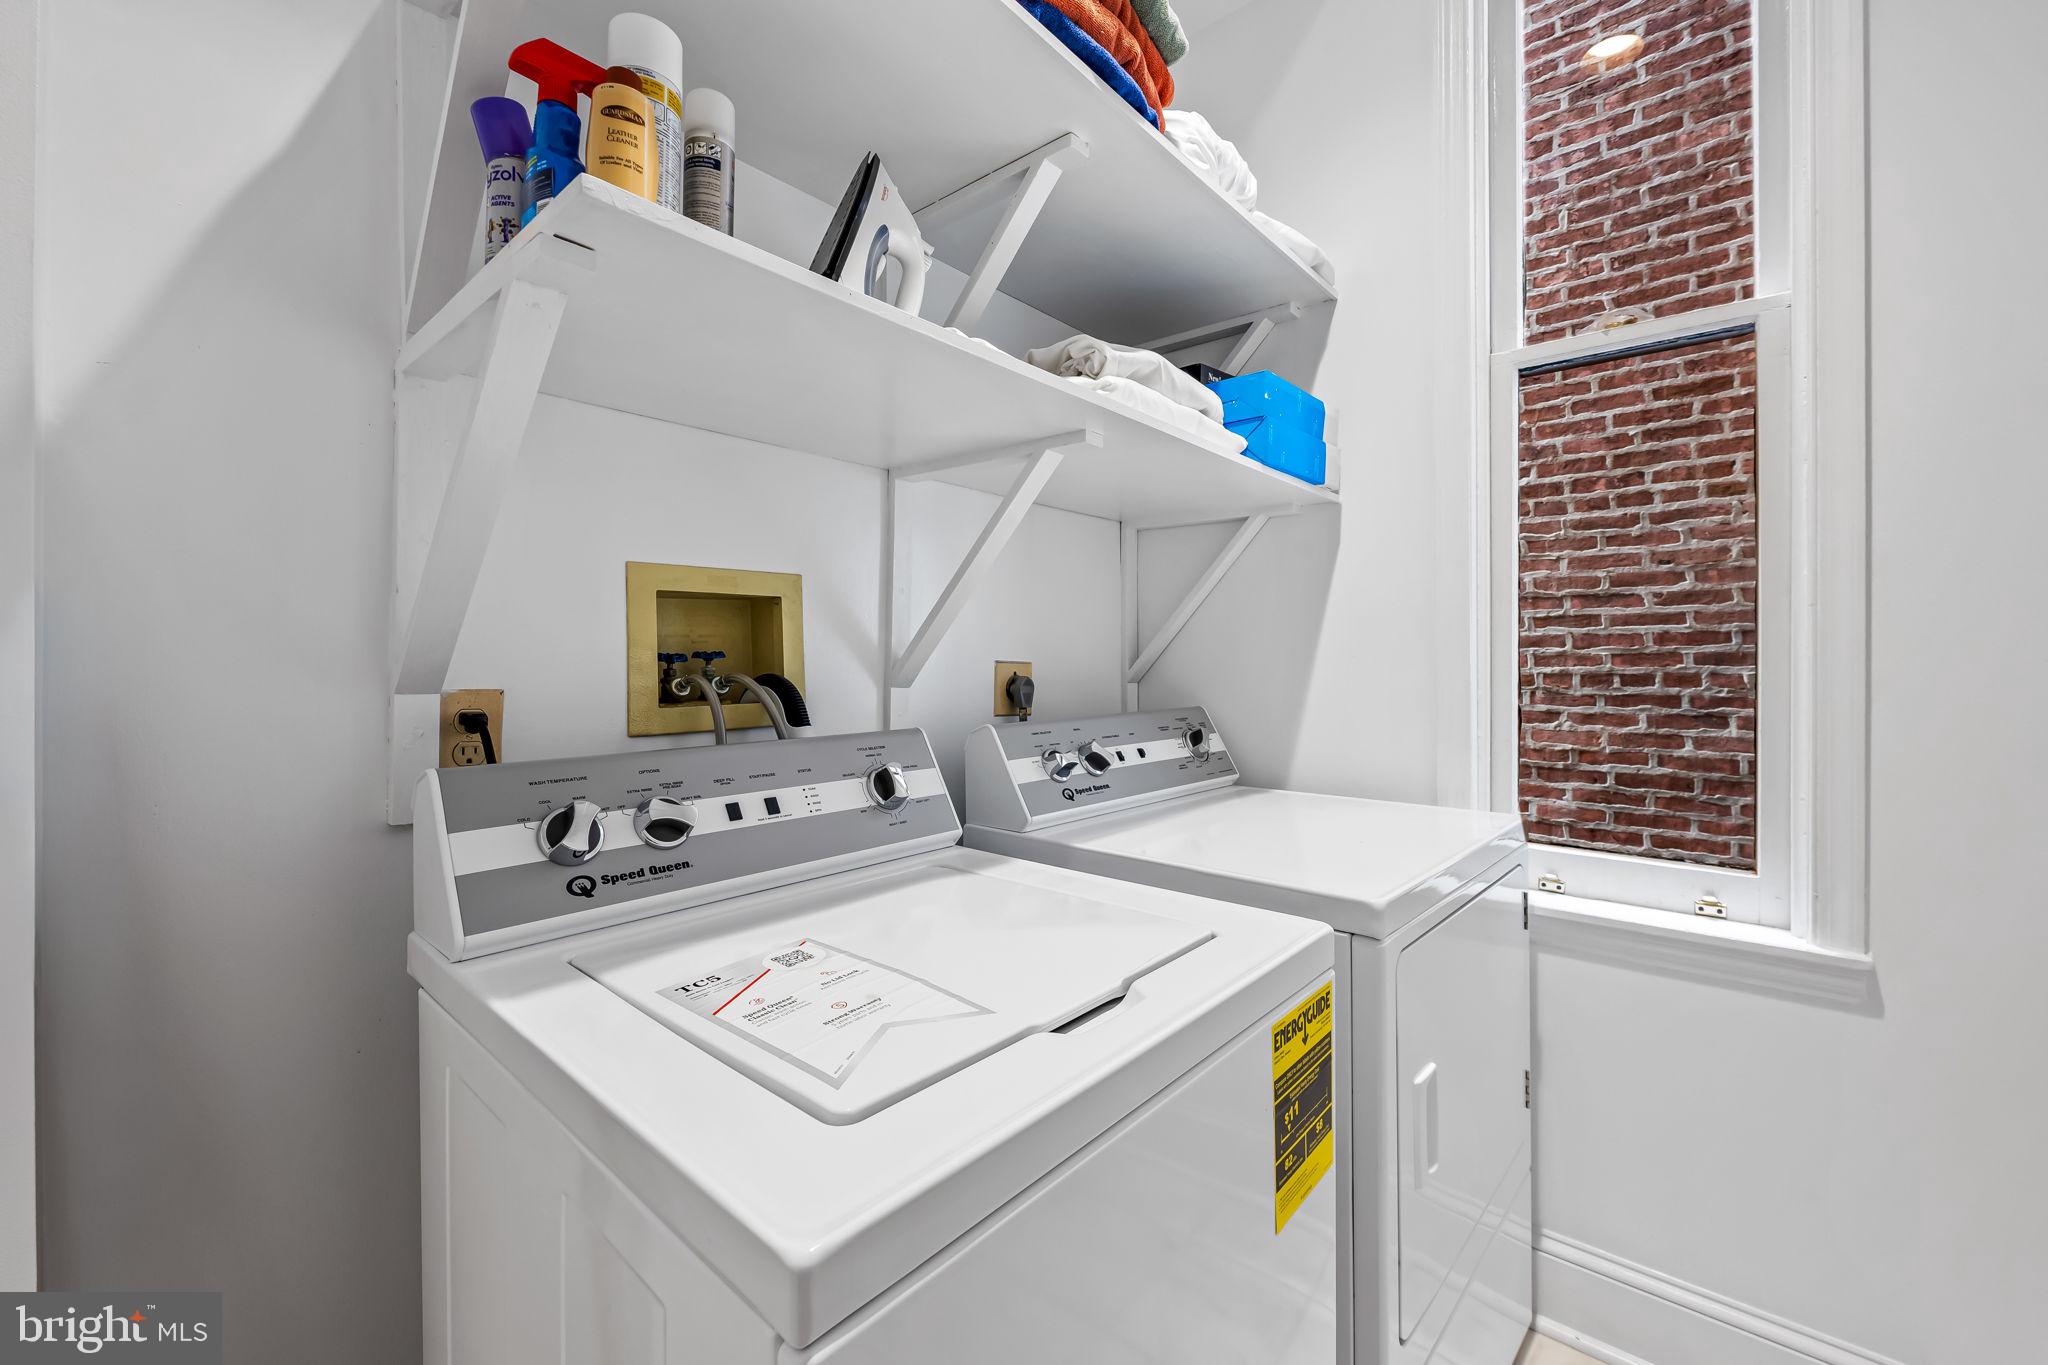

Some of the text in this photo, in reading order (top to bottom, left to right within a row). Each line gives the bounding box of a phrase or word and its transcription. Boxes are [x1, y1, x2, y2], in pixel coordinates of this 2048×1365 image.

[602, 107, 644, 124] GUARDSMAN
[606, 135, 639, 149] CLEANER
[607, 127, 638, 142] LEATHER
[546, 776, 588, 784] TEMPERATURE
[1074, 786, 1092, 795] Speed
[1092, 784, 1110, 792] Queen
[600, 868, 645, 886] Speed
[648, 861, 691, 875] Queen
[674, 975, 722, 994] TC5
[1274, 990, 1330, 1053] ENERGYGUIDE
[1284, 1100, 1299, 1125] $11
